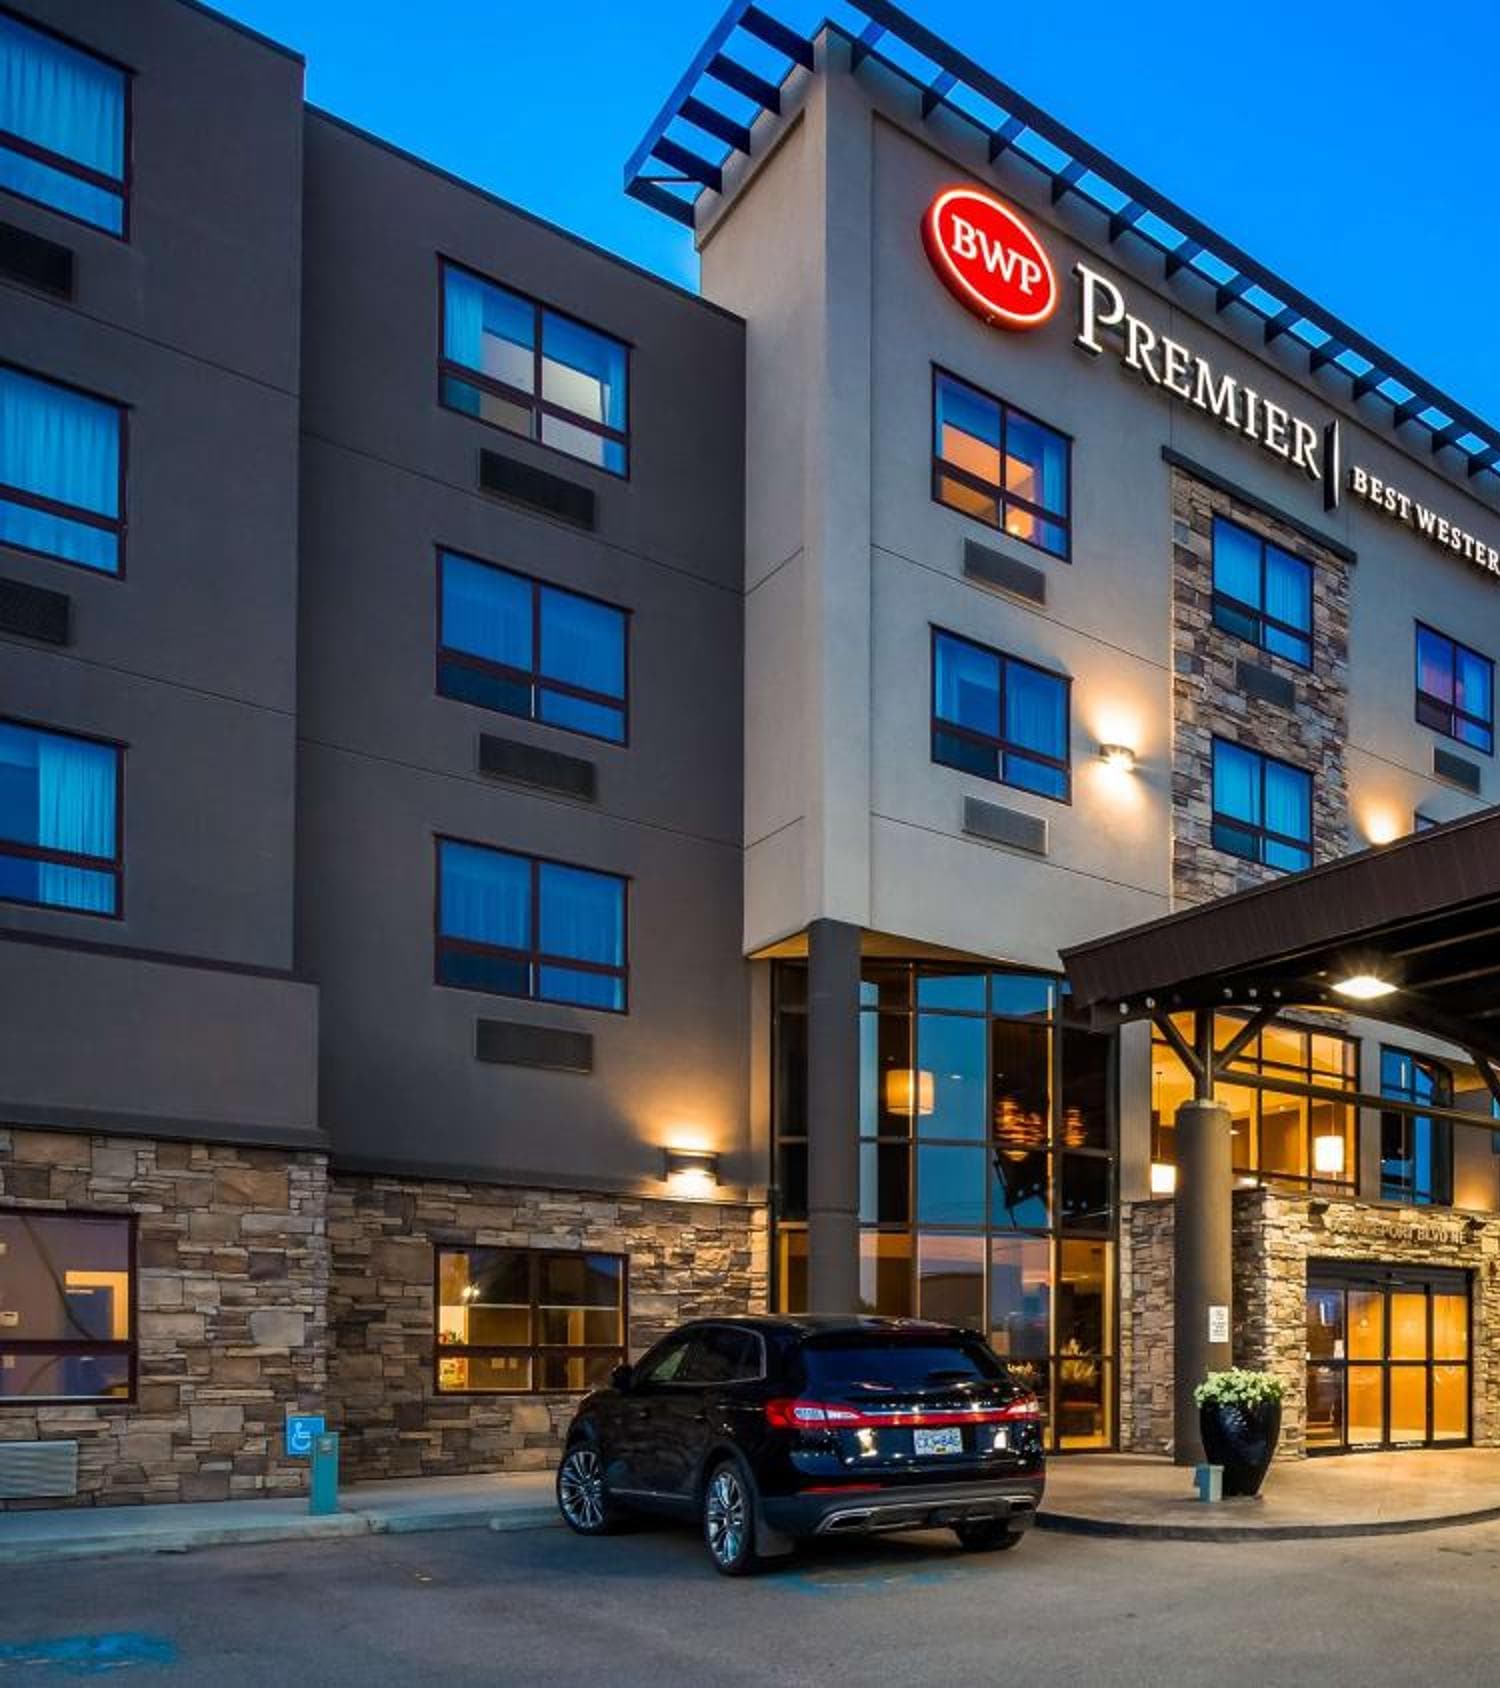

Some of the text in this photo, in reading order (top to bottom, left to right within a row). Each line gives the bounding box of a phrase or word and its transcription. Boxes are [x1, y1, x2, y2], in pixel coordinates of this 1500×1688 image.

[951, 213, 1042, 296] BWP
[1076, 262, 1321, 479] PREMIER
[1353, 466, 1411, 519] BEST
[1417, 1225, 1446, 1243] BLVD
